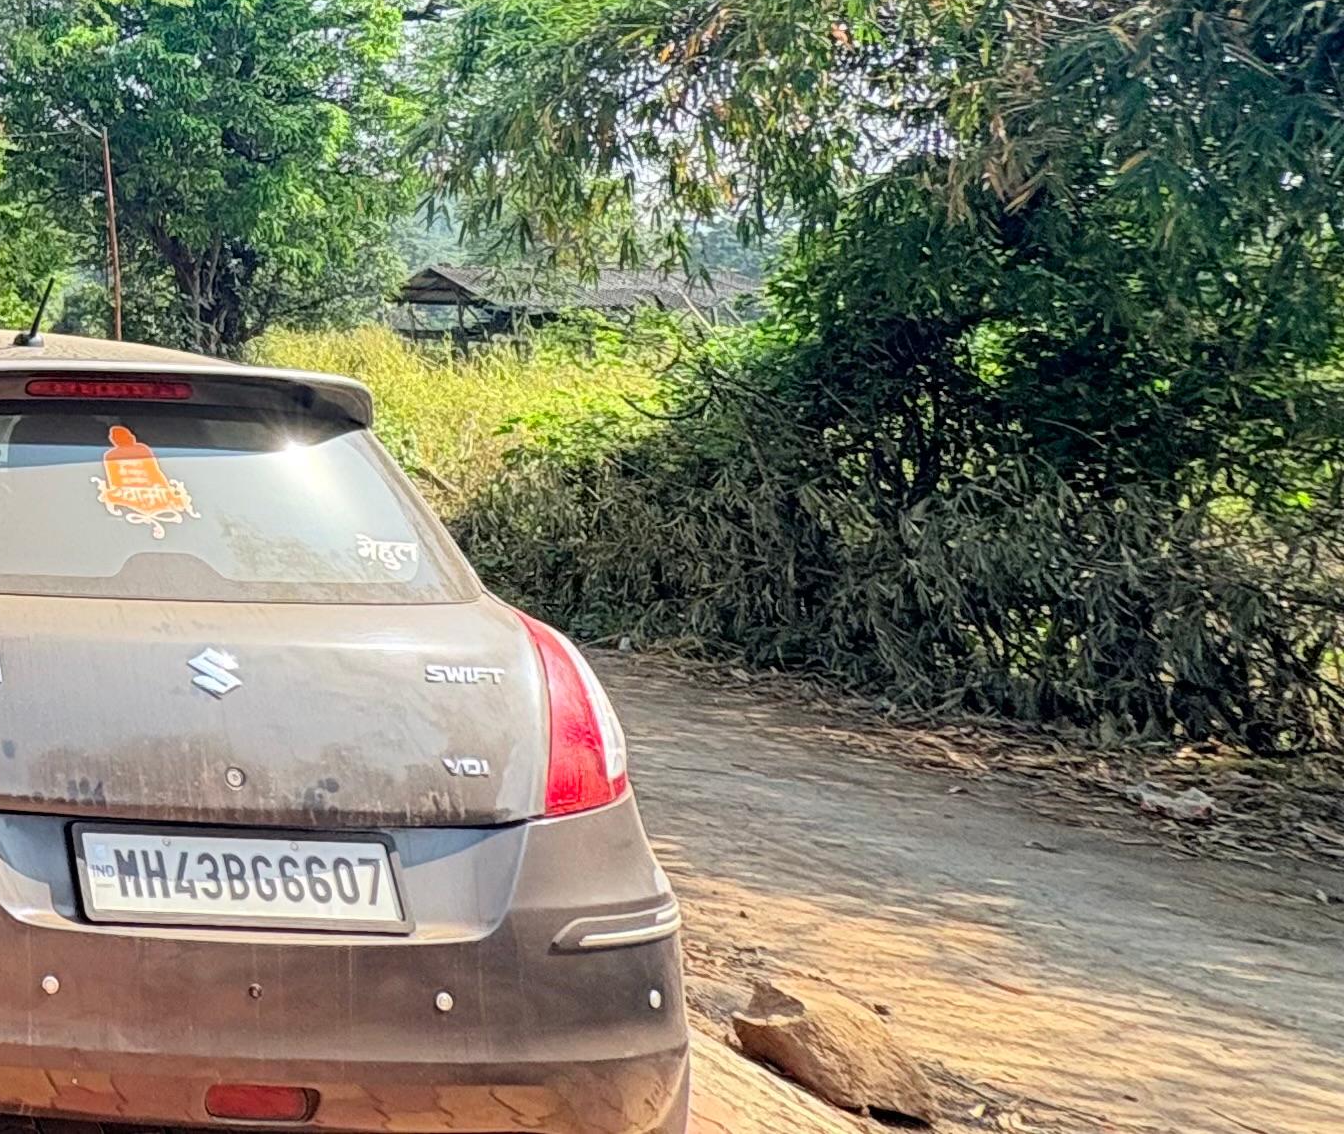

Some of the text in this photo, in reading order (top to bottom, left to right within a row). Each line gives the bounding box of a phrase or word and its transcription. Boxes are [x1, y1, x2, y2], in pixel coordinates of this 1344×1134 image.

[354, 533, 417, 570] मेहुल
[424, 664, 505, 684] SWIFT
[91, 864, 115, 878] IND
[113, 848, 381, 907] MH43BG6607
